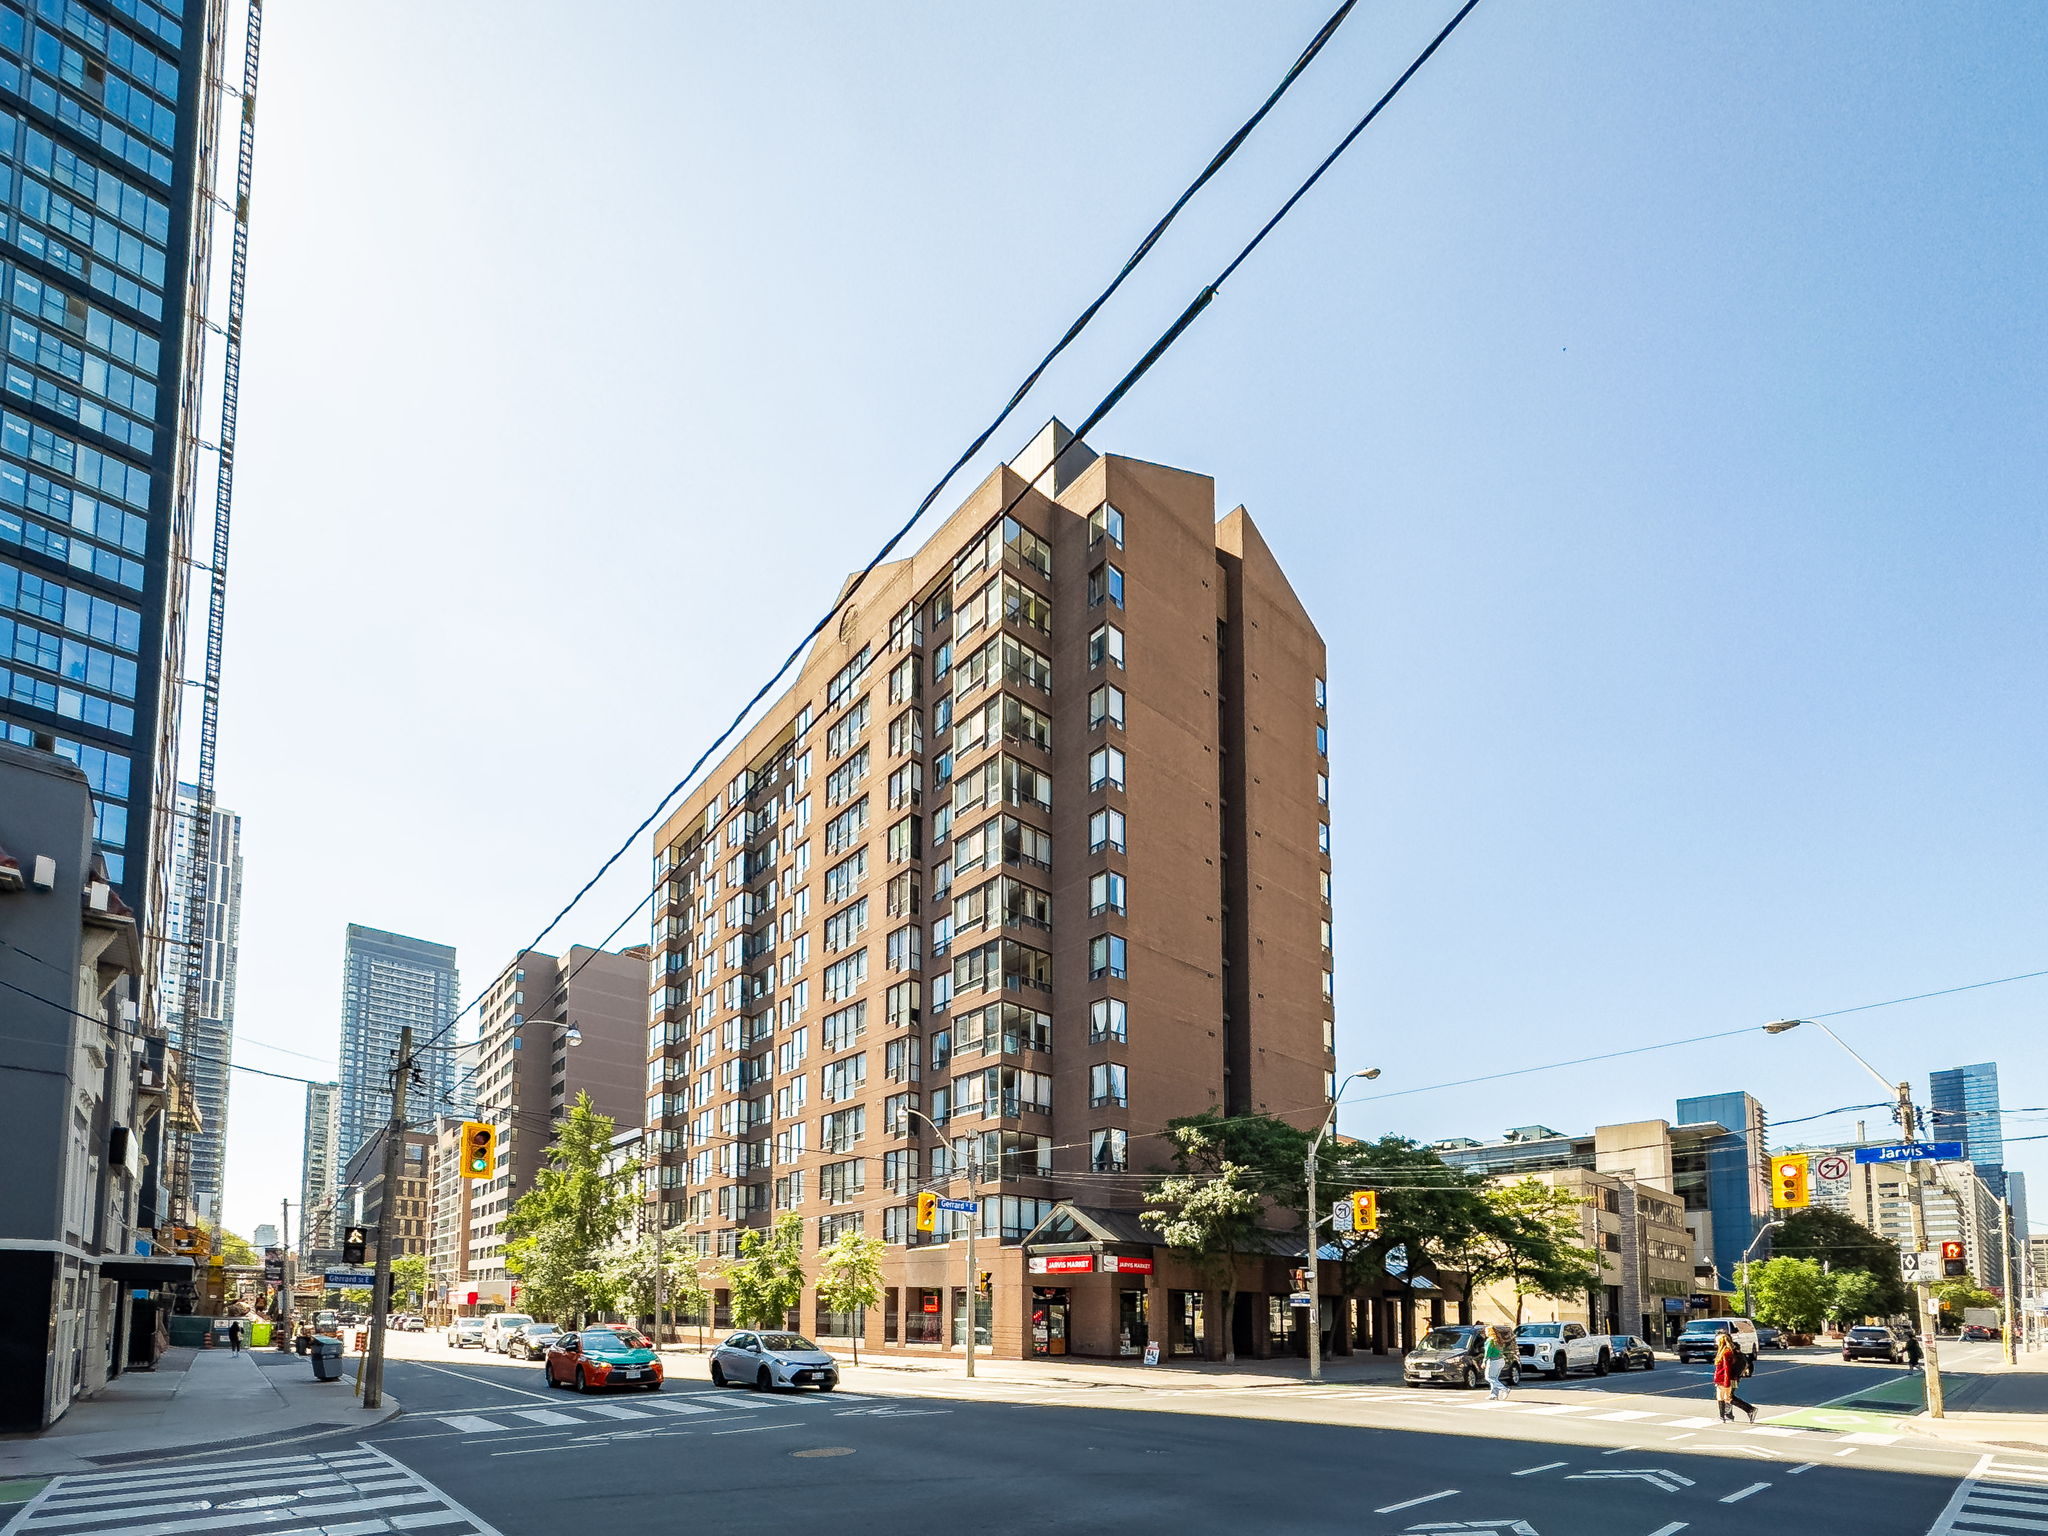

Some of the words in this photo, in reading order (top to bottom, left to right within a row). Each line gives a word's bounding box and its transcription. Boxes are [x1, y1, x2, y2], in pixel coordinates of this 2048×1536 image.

[1879, 1146, 1923, 1159] Jarvis
[940, 1200, 965, 1210] Gerrard
[970, 1203, 974, 1211] E
[1067, 1260, 1090, 1268] MARKET
[329, 1275, 357, 1283] Gerrard
